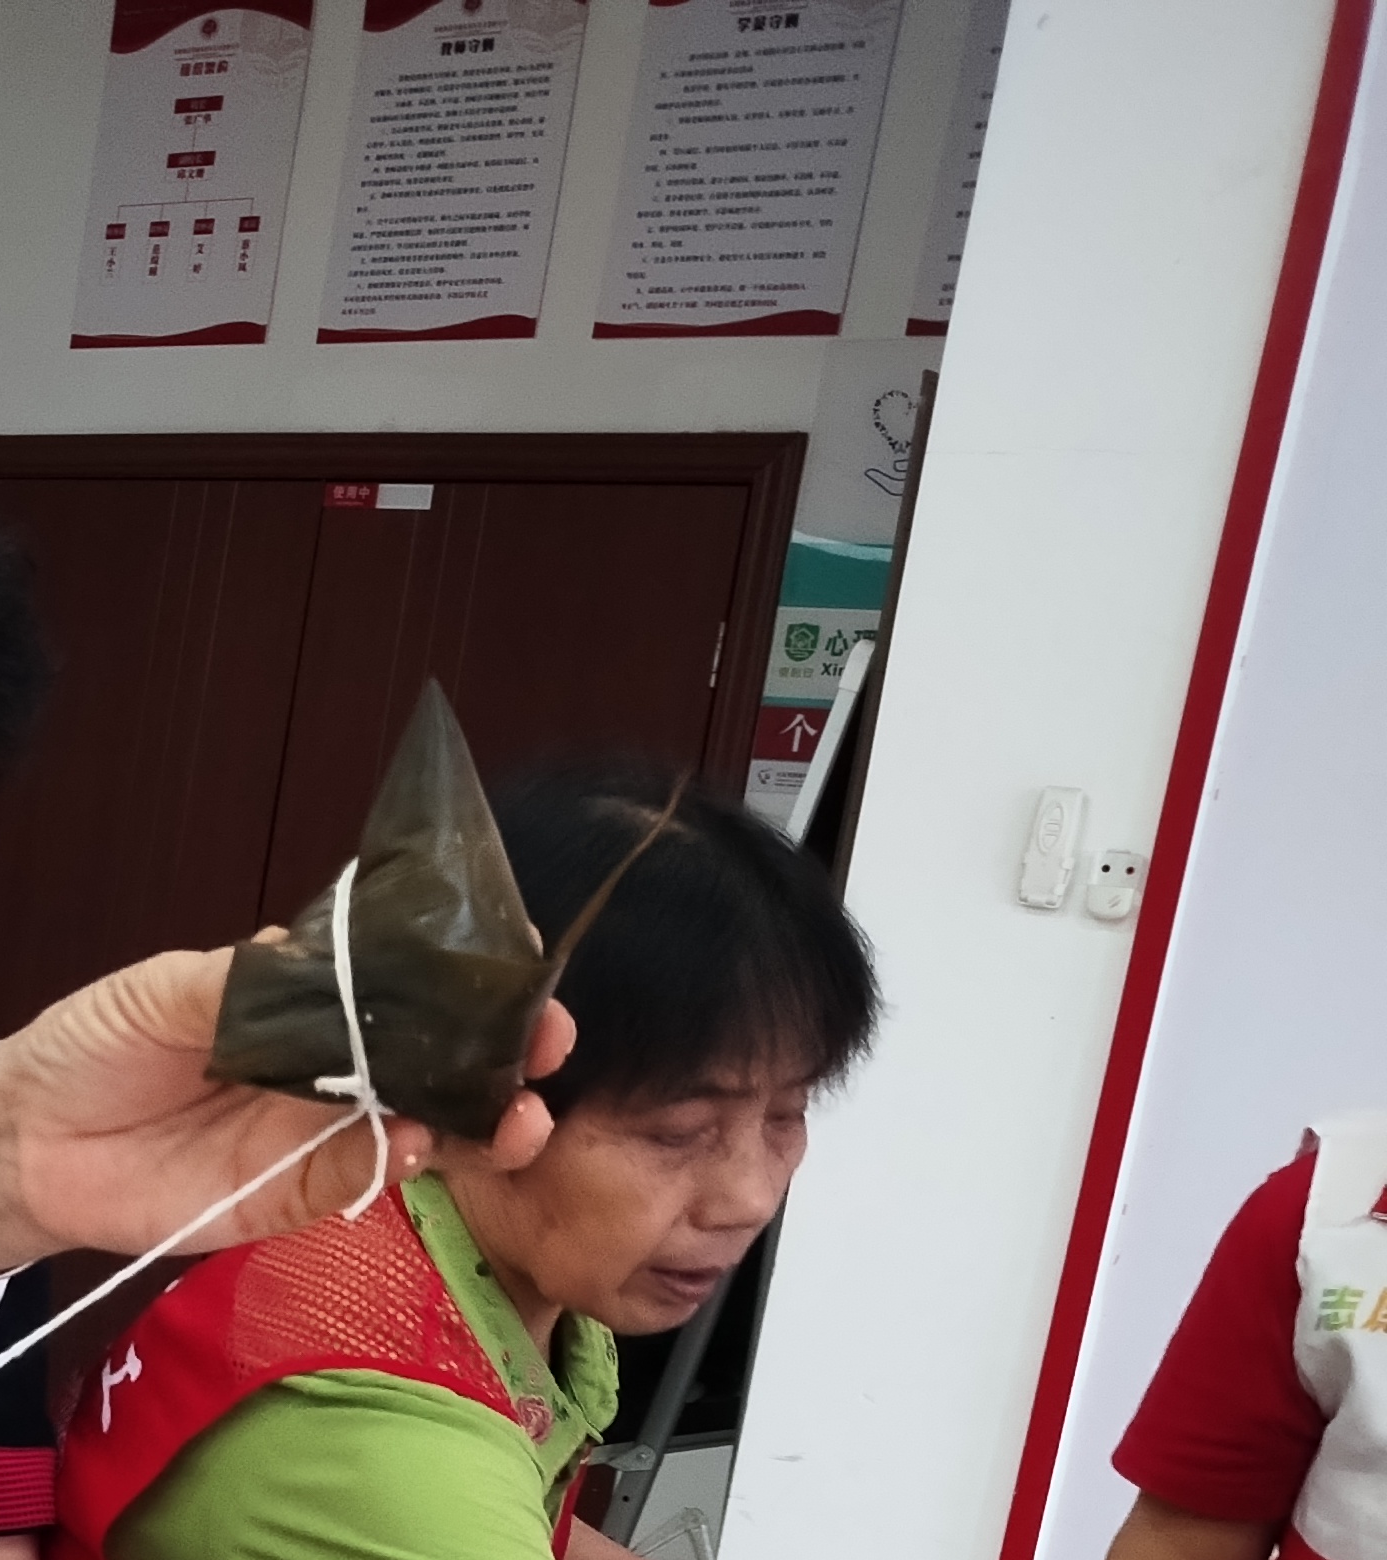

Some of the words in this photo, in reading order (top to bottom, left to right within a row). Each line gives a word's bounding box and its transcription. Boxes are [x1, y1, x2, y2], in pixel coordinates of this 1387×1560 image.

[333, 485, 371, 500] 使用中
[780, 713, 818, 753] 个
